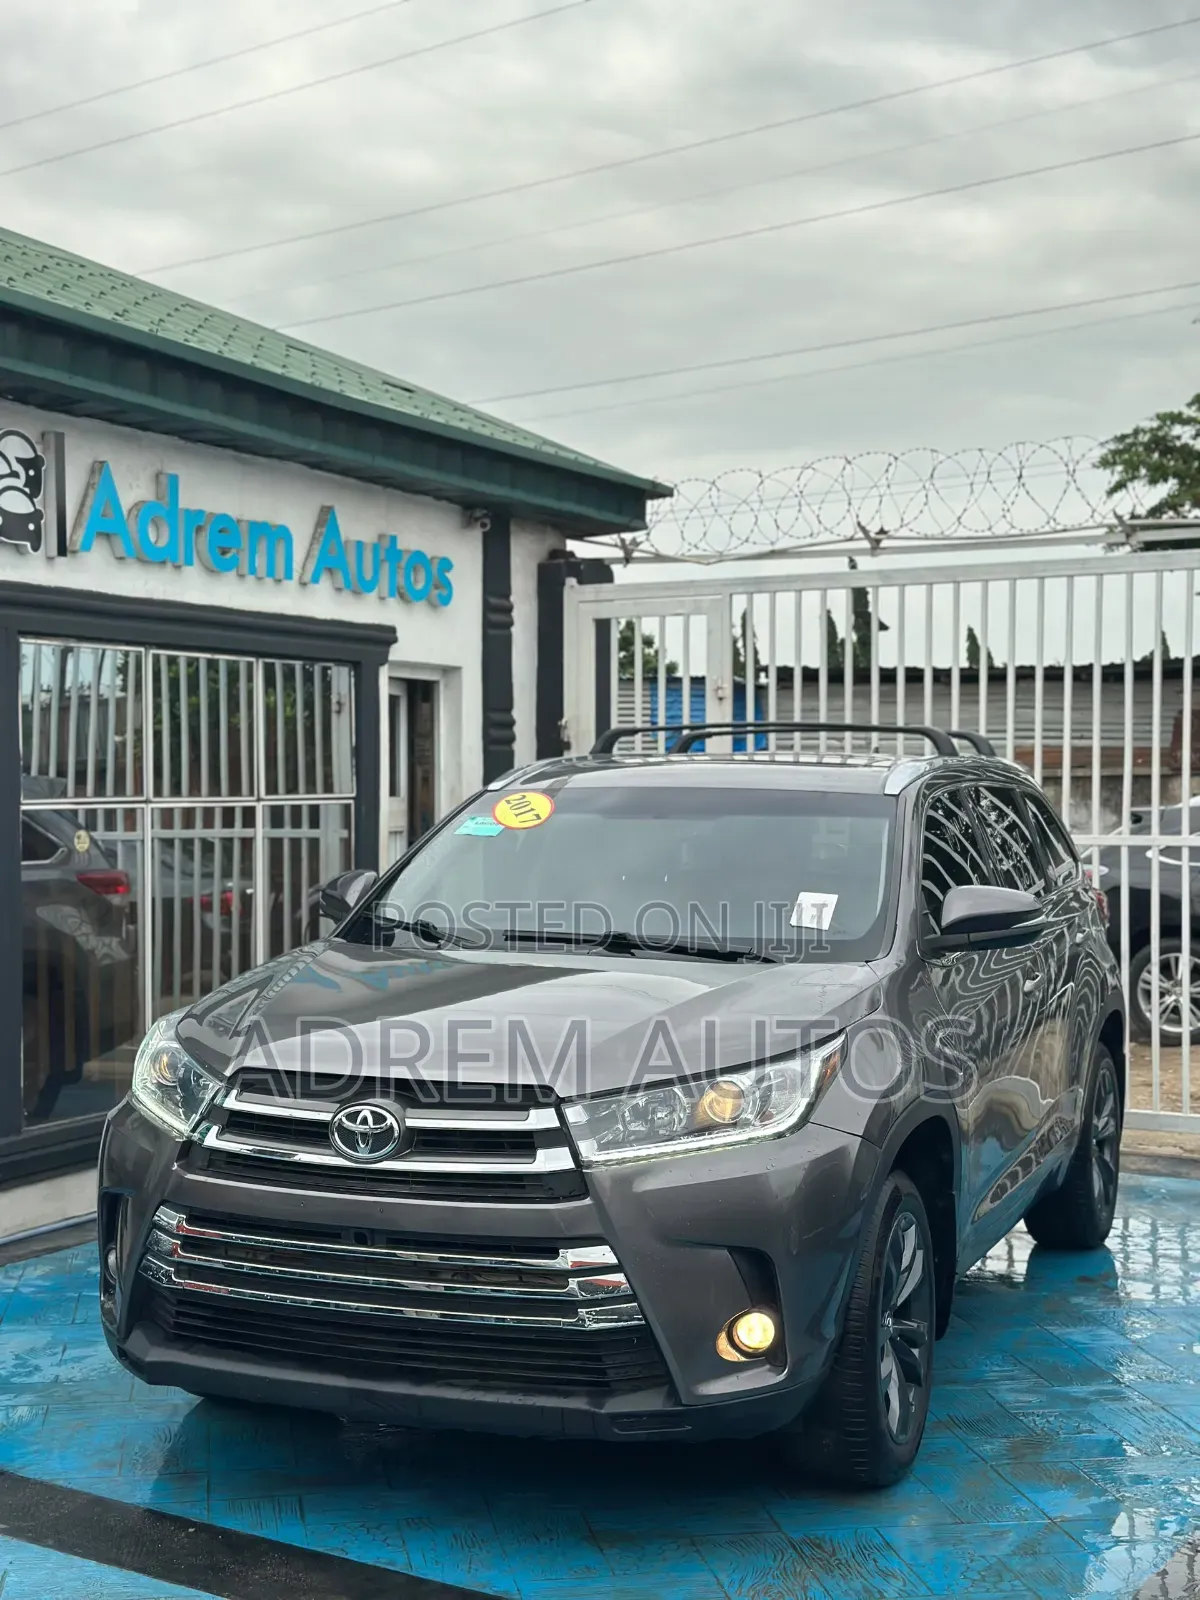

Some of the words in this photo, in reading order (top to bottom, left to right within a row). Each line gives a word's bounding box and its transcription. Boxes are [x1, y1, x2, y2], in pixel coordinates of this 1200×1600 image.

[72, 461, 294, 581] Adrem
[304, 505, 454, 607] Autos
[504, 794, 542, 824] 2017
